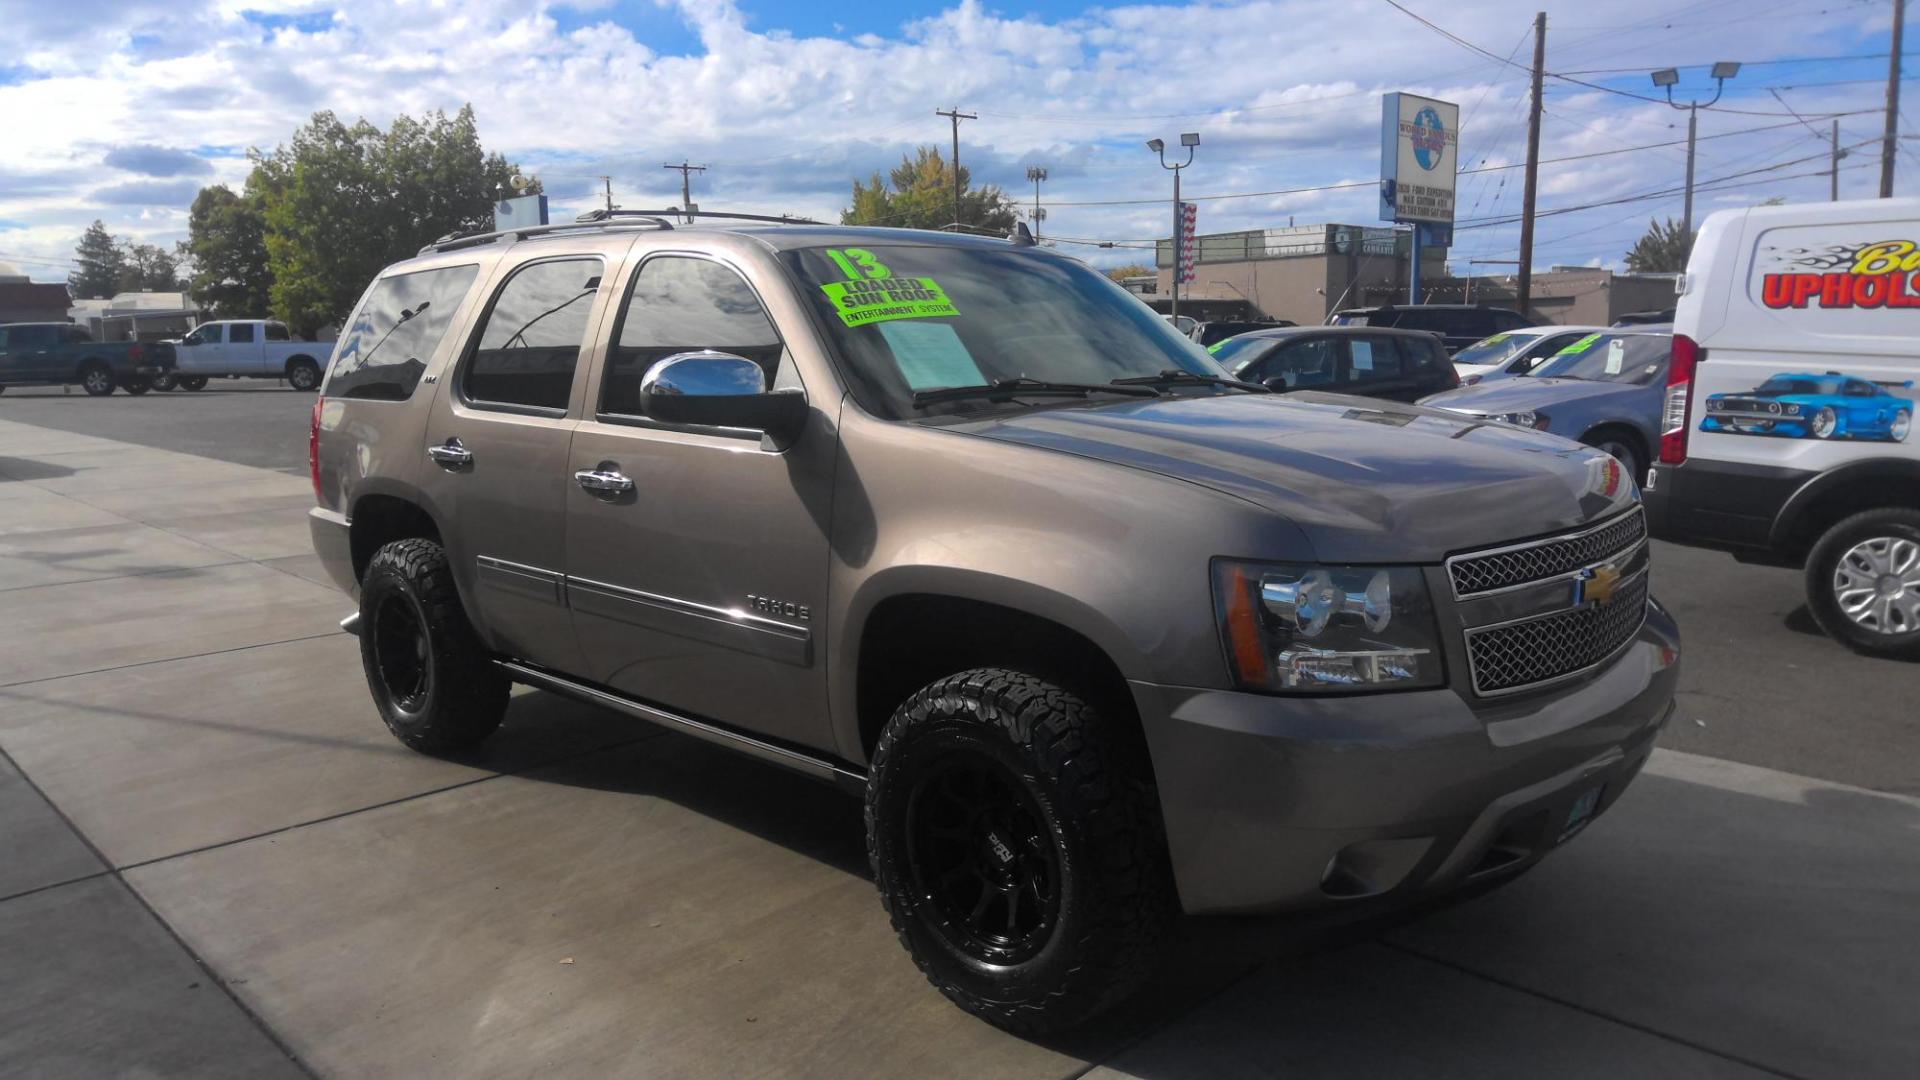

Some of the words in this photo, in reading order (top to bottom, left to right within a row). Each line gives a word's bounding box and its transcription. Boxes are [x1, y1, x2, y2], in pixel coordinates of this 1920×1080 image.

[1400, 123, 1427, 136] WORLD
[1412, 185, 1425, 195] FORD
[826, 248, 891, 280] 13
[841, 278, 924, 294] LOADED
[841, 291, 884, 308] SUN
[889, 288, 938, 303] ROOF
[845, 305, 915, 323] ENTERTAINMENT
[918, 303, 953, 313] SYSTEM
[746, 594, 809, 619] TAHOE
